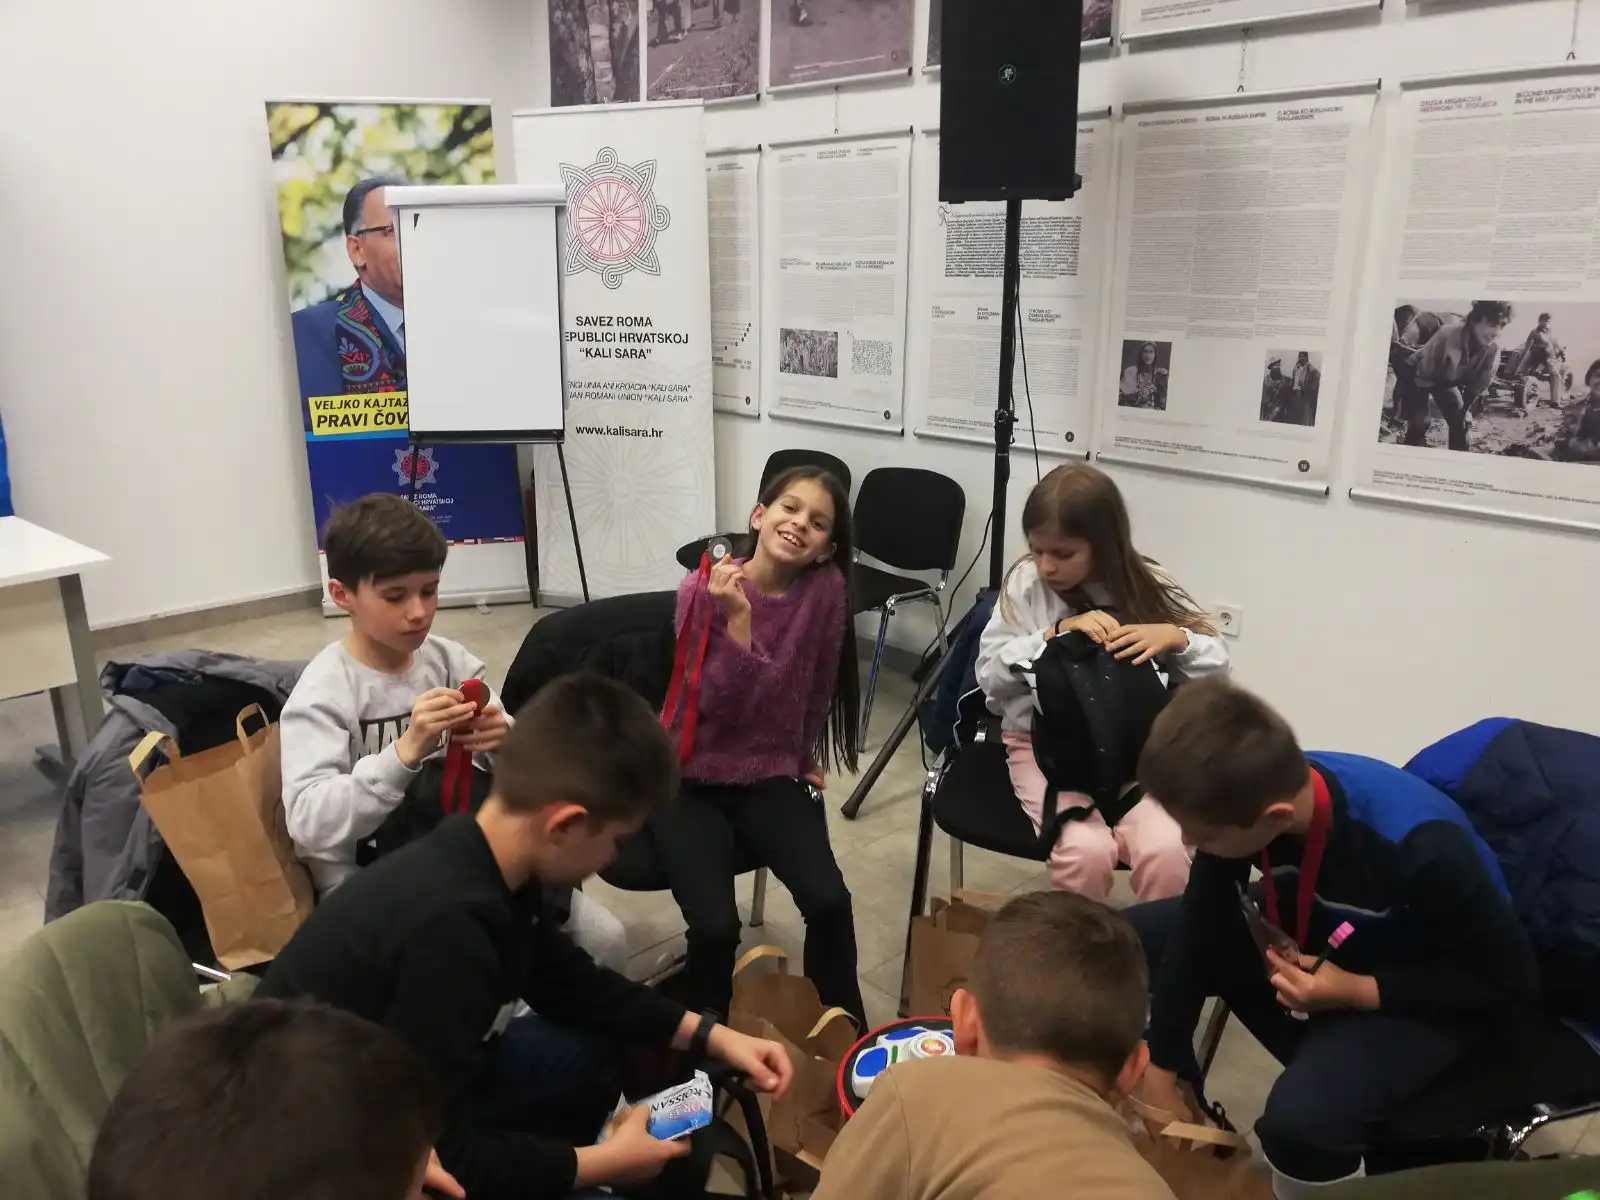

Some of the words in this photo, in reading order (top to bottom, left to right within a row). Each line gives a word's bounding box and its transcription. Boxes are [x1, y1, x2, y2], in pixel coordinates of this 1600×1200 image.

[576, 316, 613, 327] SAVEZ
[617, 316, 653, 327] ROMA
[619, 332, 689, 344] HRVATSKOJ
[579, 347, 612, 359] “KALI
[614, 348, 652, 360] SARA”
[315, 399, 360, 411] VELJKO
[316, 411, 368, 428] PRAVI
[373, 408, 408, 426] ČOV
[576, 424, 664, 438] www.kalisara.hr
